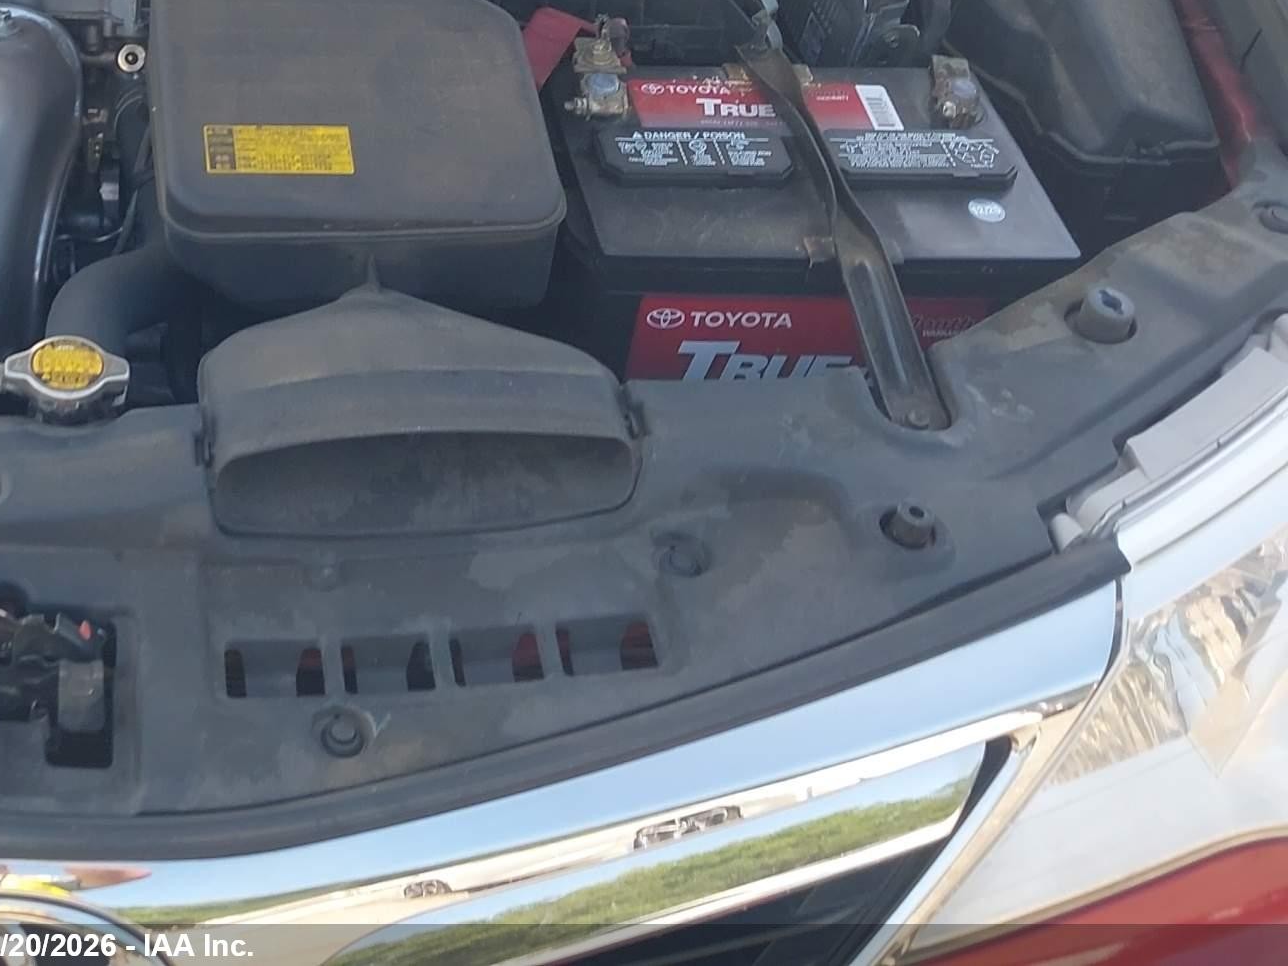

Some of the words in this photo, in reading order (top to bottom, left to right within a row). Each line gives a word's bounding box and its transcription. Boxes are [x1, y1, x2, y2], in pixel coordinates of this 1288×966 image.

[667, 84, 731, 95] TOYOTA
[695, 98, 776, 117] TRUE
[690, 311, 793, 329] TOYOTA
